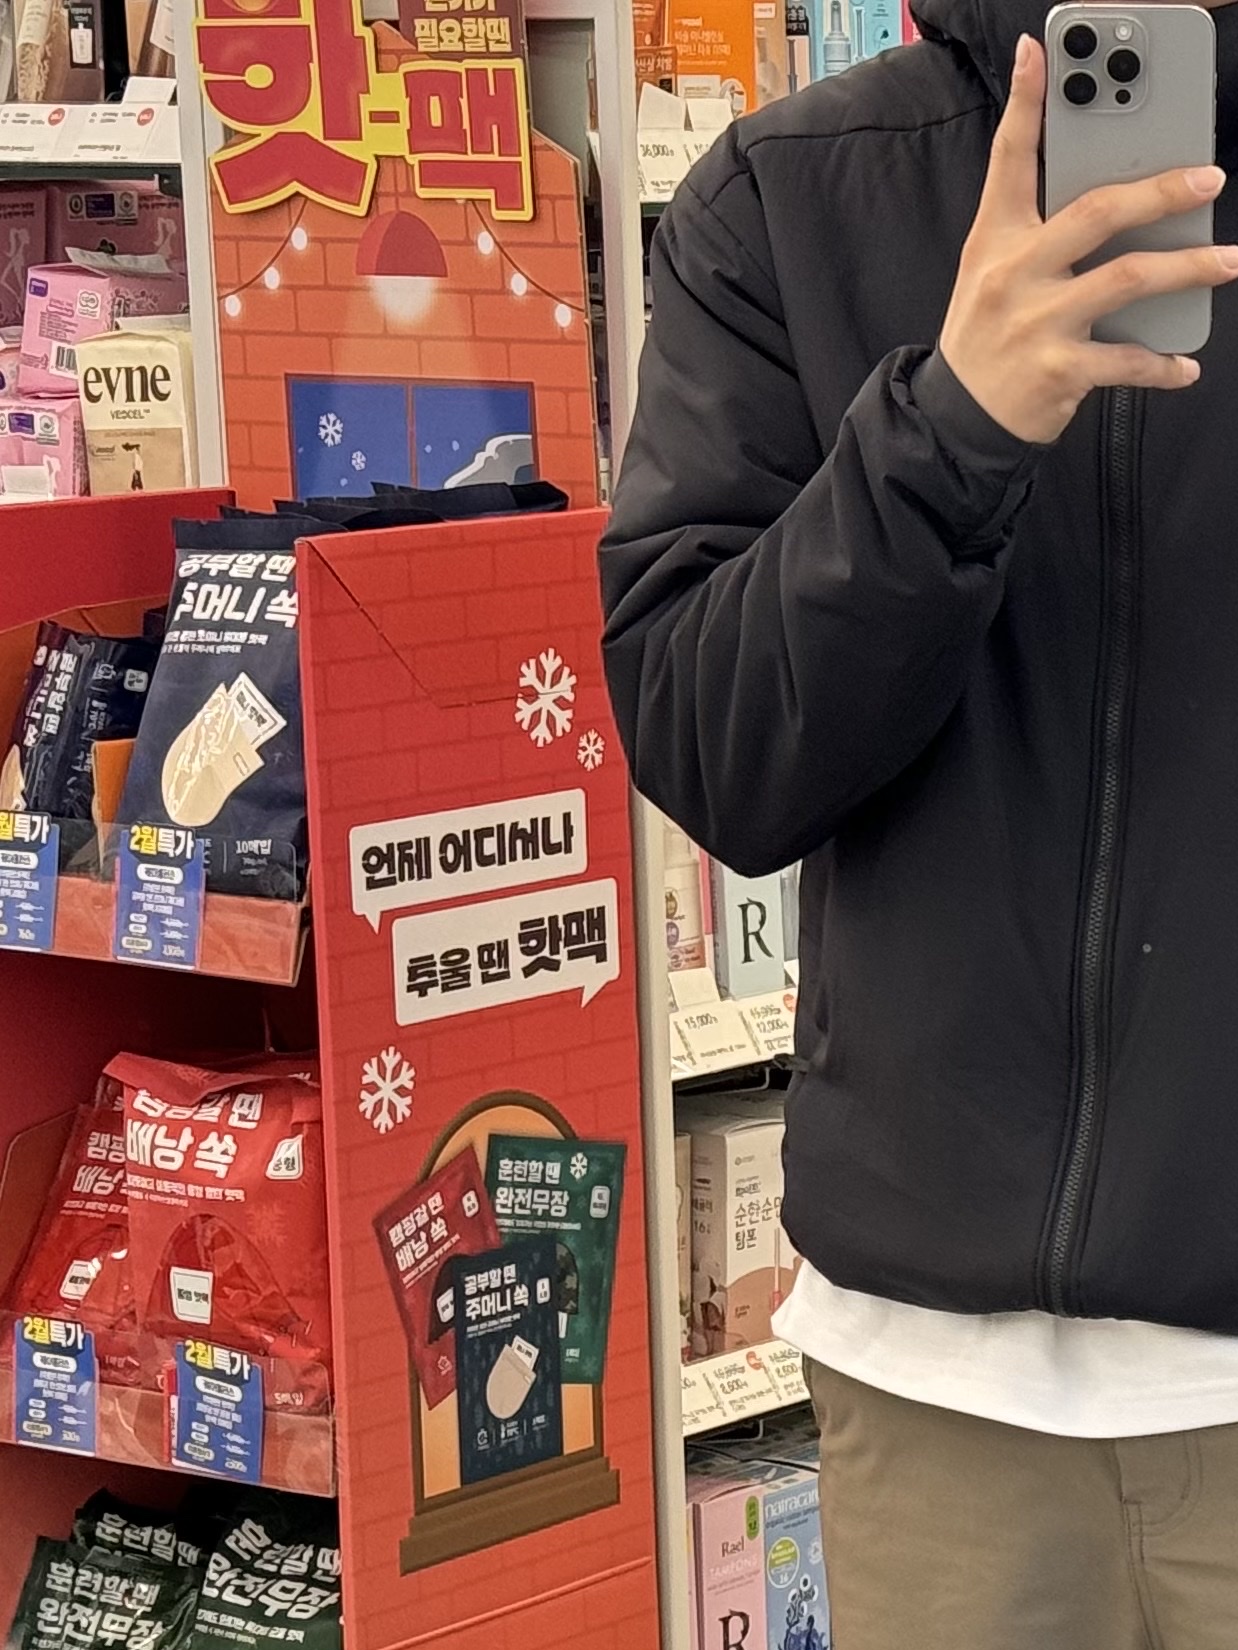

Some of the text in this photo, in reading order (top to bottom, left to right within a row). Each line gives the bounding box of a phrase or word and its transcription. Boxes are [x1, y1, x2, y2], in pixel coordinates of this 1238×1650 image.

[414, 17, 512, 52] 필요할땐
[83, 364, 172, 404] evne
[178, 553, 297, 582] 공부할 땐
[362, 811, 574, 891] 언제 어디서나
[737, 897, 774, 964] R
[406, 905, 608, 998] 추울 땐 핫팩
[126, 1118, 237, 1178] 배낭 쏙
[494, 1186, 571, 1217] 완전무장
[394, 1231, 429, 1272] 배낭
[464, 1267, 503, 1296] 공부할
[465, 1288, 512, 1322] 주머니
[185, 1339, 251, 1380] 2월특가
[202, 1552, 340, 1620] 완전무장
[36, 1597, 164, 1650] 완전무장
